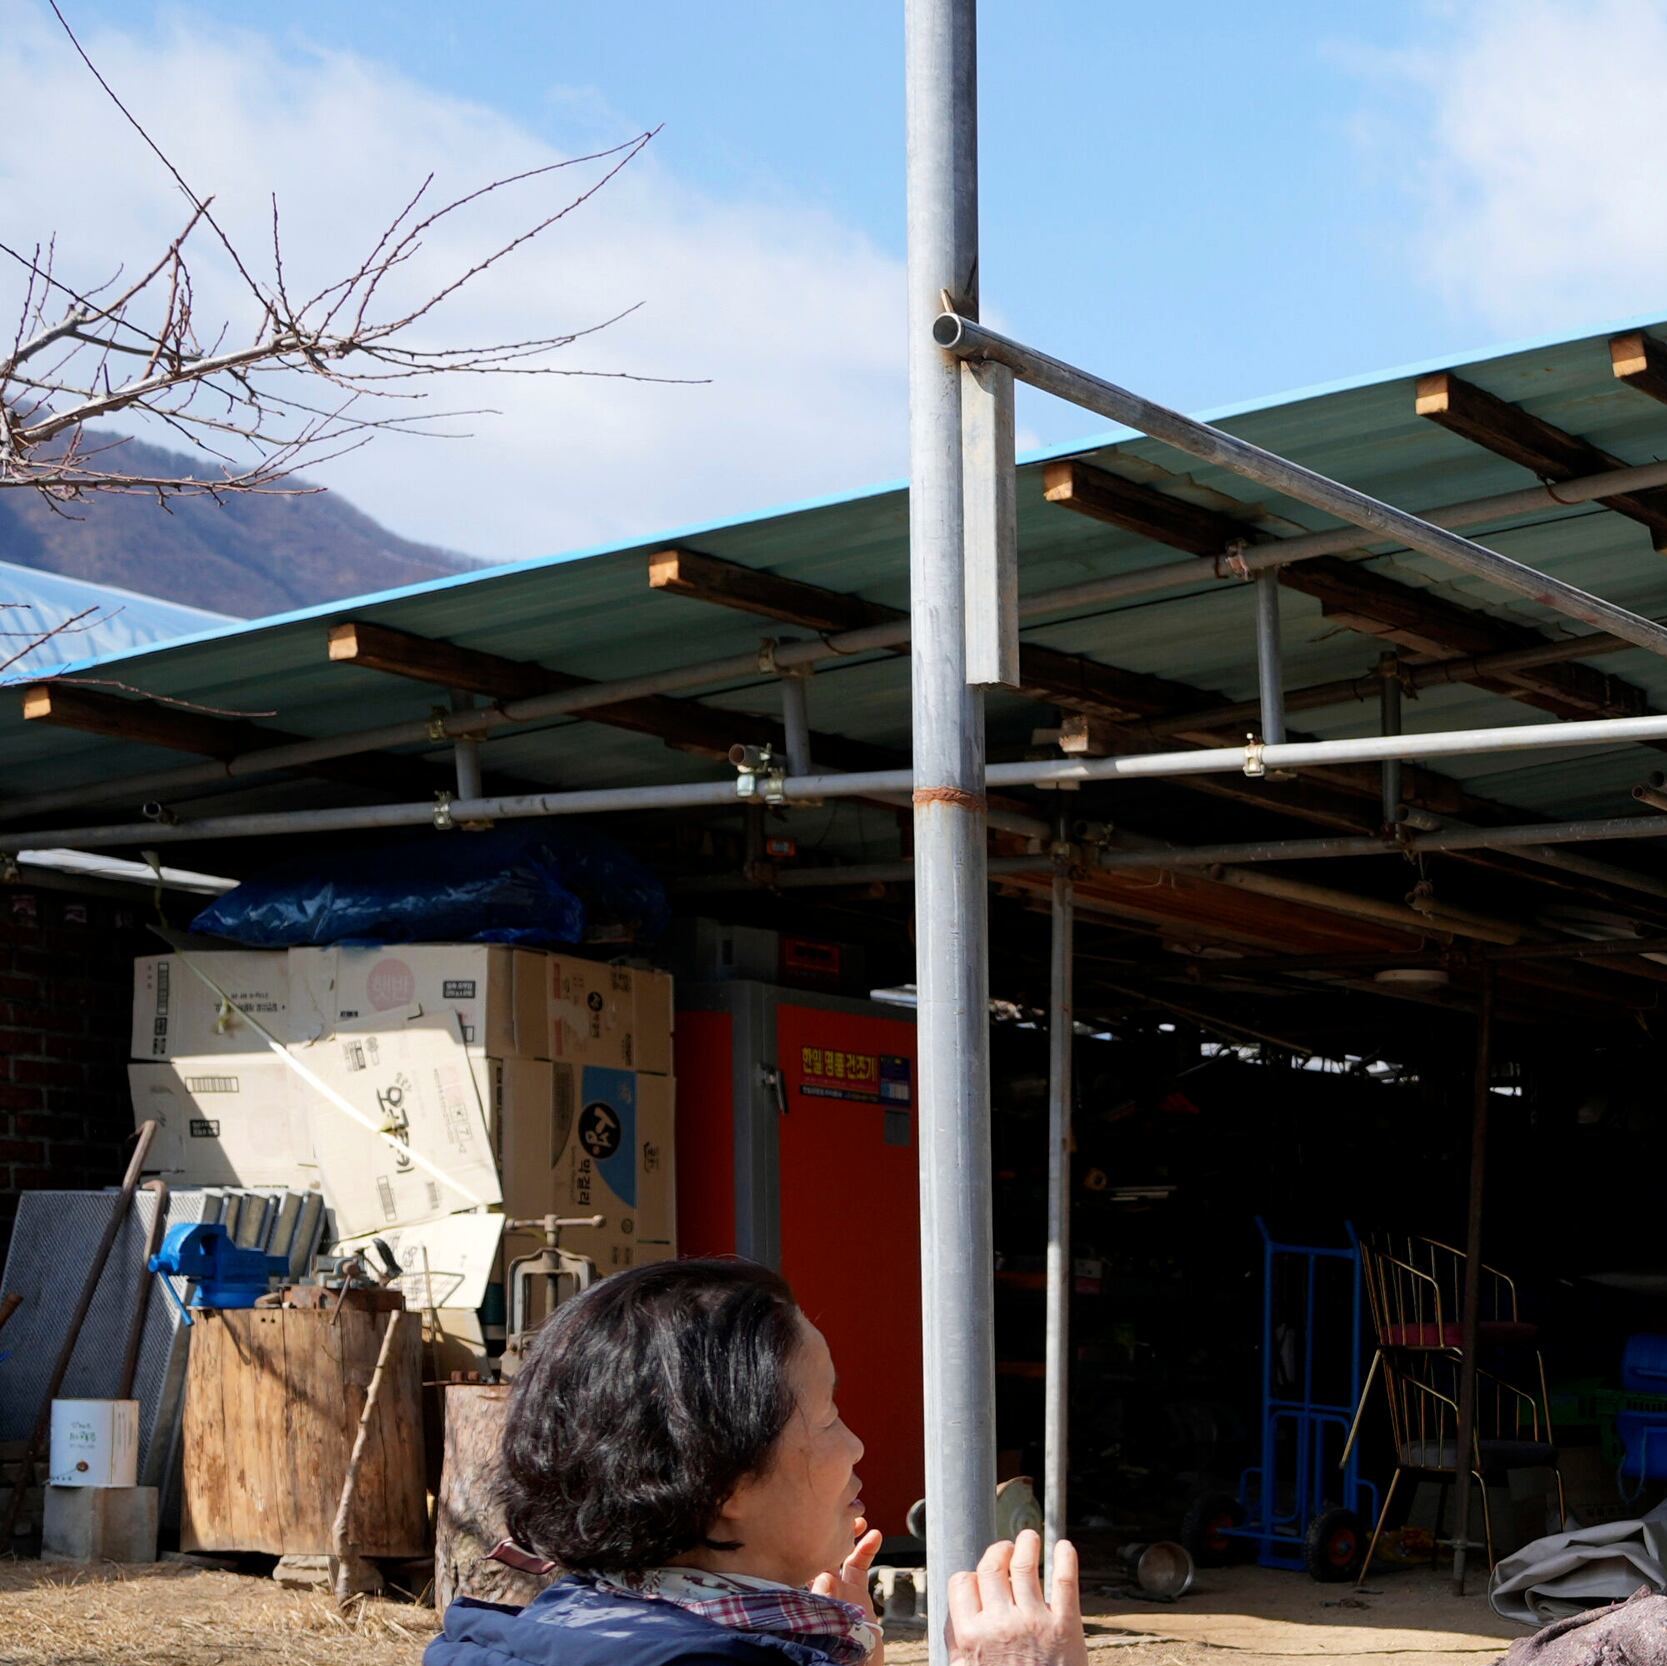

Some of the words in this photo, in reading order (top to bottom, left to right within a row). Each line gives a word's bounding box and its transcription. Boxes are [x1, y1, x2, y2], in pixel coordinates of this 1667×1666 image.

[801, 1047, 823, 1076] 한일
[846, 1053, 878, 1082] 건조기
[577, 1158, 592, 1206] 막걸리
